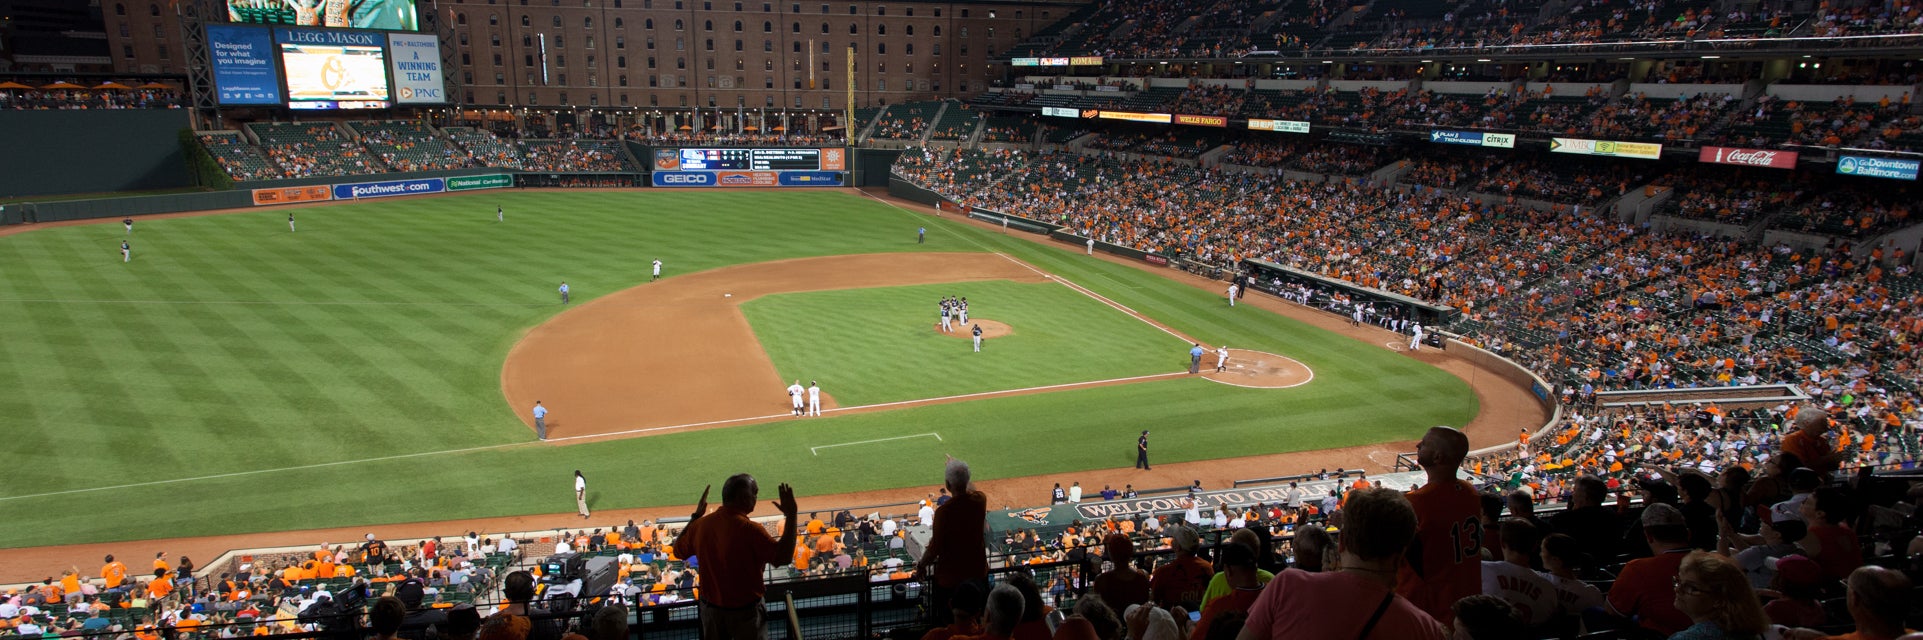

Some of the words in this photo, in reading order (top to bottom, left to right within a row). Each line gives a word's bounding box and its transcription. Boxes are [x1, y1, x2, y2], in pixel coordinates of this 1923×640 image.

[288, 31, 325, 43] LEGG
[328, 32, 373, 44] MASON
[214, 42, 252, 50] Designed
[413, 51, 419, 60] A
[234, 58, 266, 66] imagine
[397, 61, 437, 71] WINNING
[1072, 57, 1092, 65] ROMA
[406, 72, 431, 81] TEAM
[414, 88, 440, 98] PNC
[1179, 116, 1200, 124] WELLS
[1201, 117, 1222, 125] FARGO
[1564, 140, 1594, 151] UMBC
[1858, 158, 1919, 170] GoDowntown
[1857, 166, 1917, 180] Baltimore.com
[663, 174, 707, 183] GEICO
[1082, 497, 1208, 517] WELCOME
[1208, 492, 1245, 505] TO
[1451, 514, 1481, 564] 13
[370, 547, 380, 557] 10
[1496, 575, 1542, 601] DAVIS
